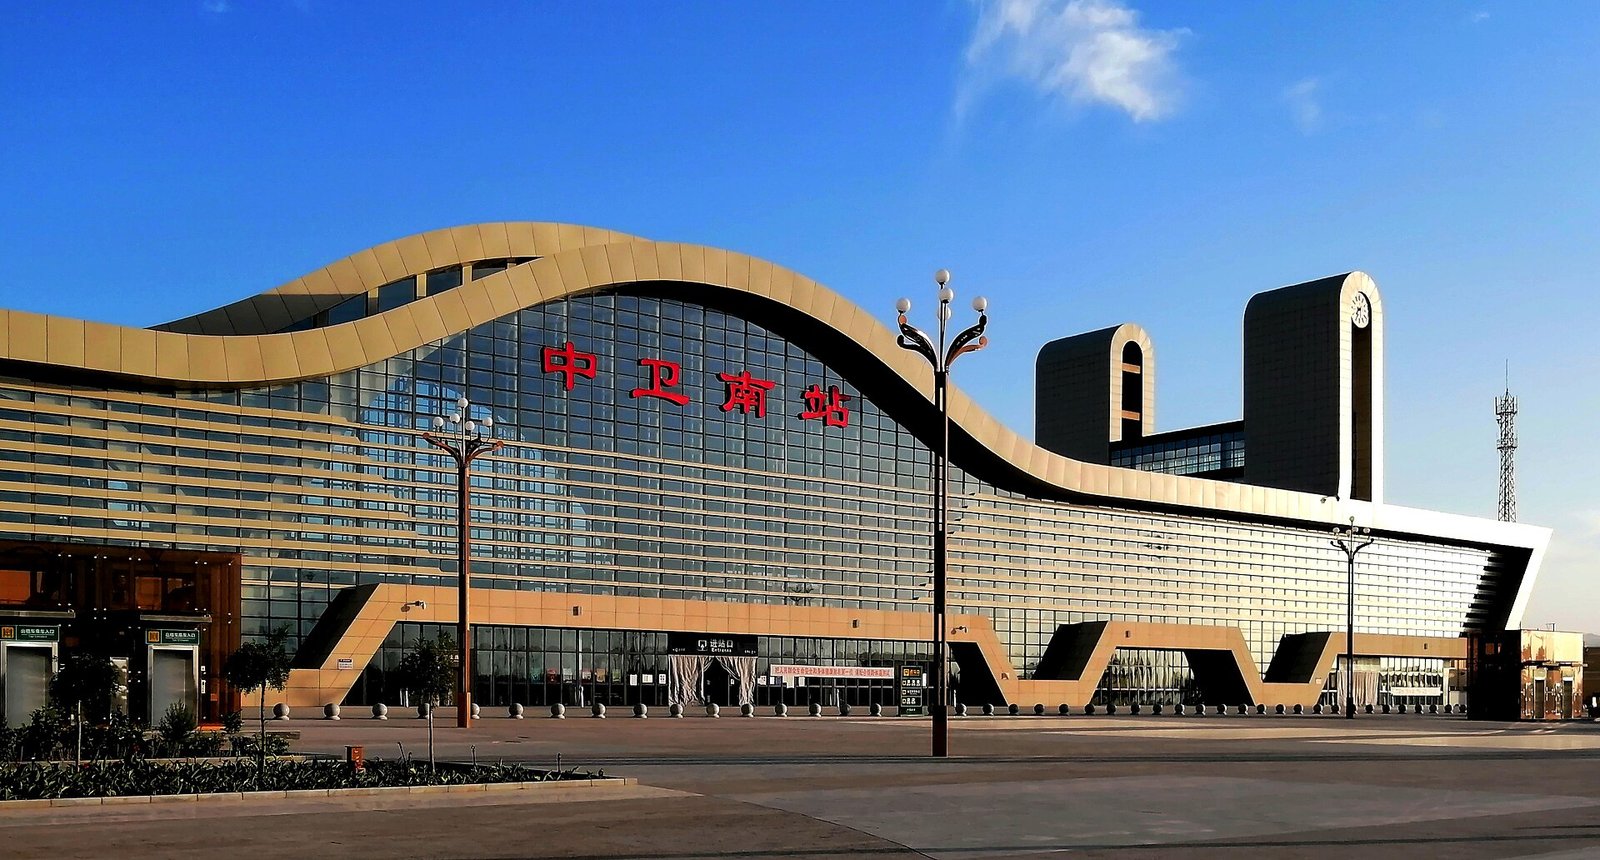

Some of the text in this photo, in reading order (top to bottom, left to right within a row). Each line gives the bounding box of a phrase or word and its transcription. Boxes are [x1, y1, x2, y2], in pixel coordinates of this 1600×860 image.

[541, 341, 852, 428] 中卫南站
[709, 638, 734, 648] 进站口
